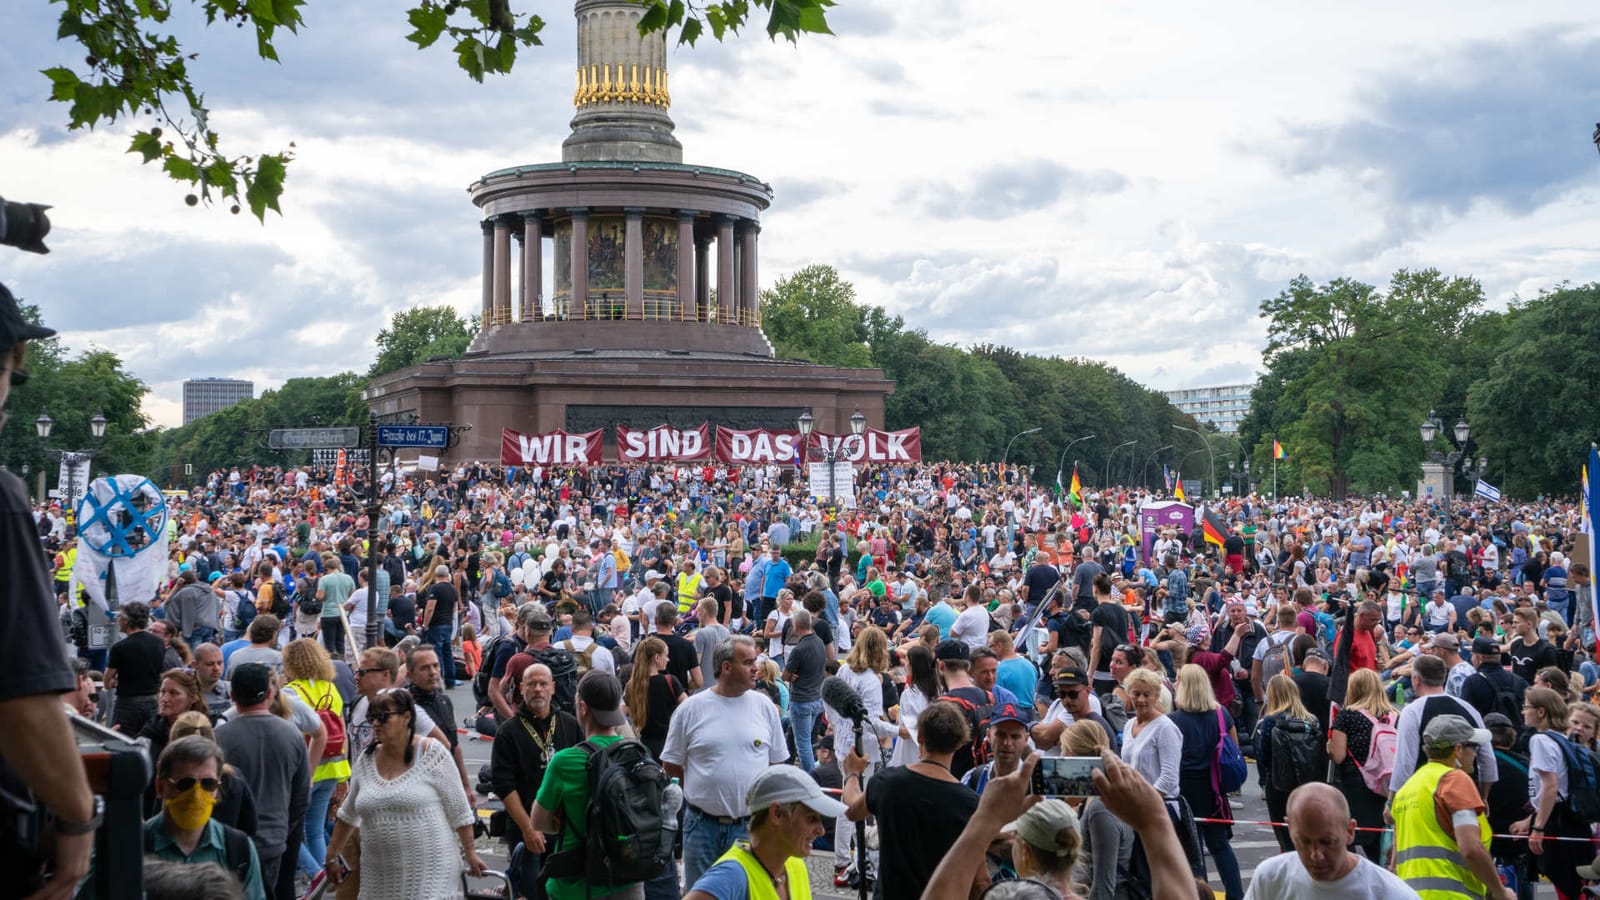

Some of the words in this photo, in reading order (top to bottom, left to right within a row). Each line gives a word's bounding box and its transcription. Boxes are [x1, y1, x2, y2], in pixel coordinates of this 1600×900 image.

[406, 429, 417, 442] des
[418, 430, 427, 441] 17.
[428, 430, 444, 445] Juni
[519, 434, 589, 464] WIR
[625, 428, 704, 458] SIND
[731, 433, 794, 461] DAS
[818, 432, 911, 462] VOLK
[59, 486, 82, 497] sele
